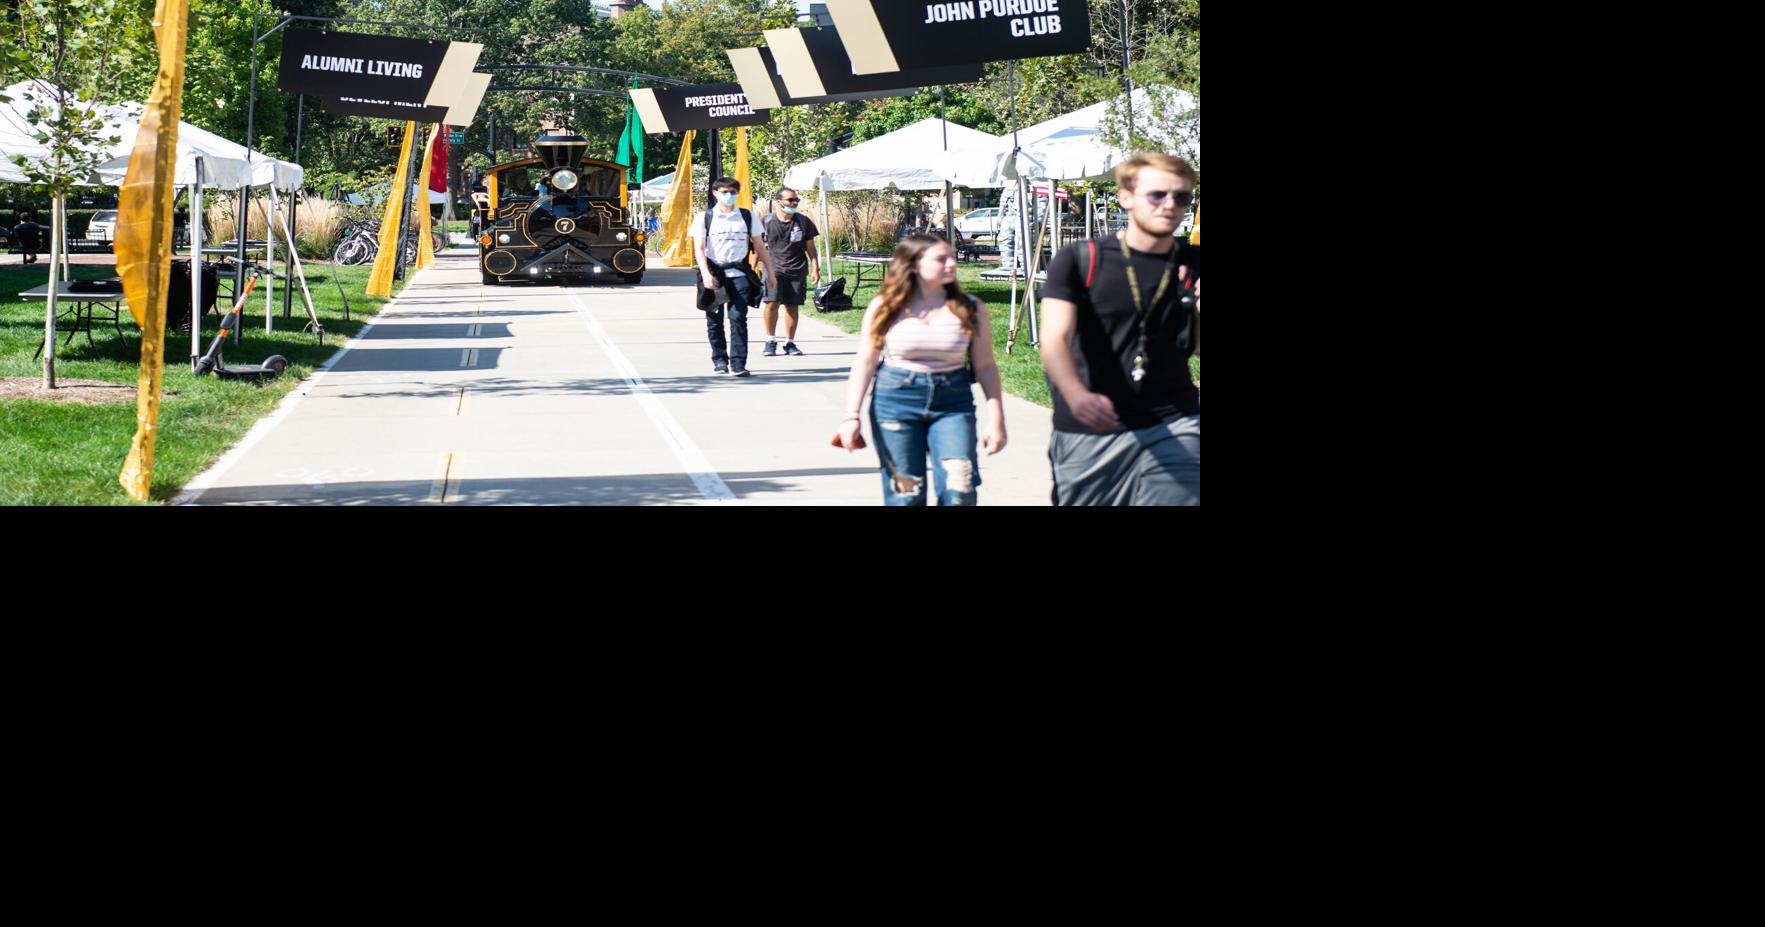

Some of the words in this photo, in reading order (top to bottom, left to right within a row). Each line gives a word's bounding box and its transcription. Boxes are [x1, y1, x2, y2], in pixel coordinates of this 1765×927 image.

[925, 1, 975, 24] JOHN
[978, 0, 1059, 18] PURDUE
[1010, 15, 1062, 37] CLUB
[301, 54, 364, 74] ALUMNI
[367, 60, 423, 79] LIVING
[709, 104, 756, 117] COUNCIL
[560, 221, 570, 231] 7
